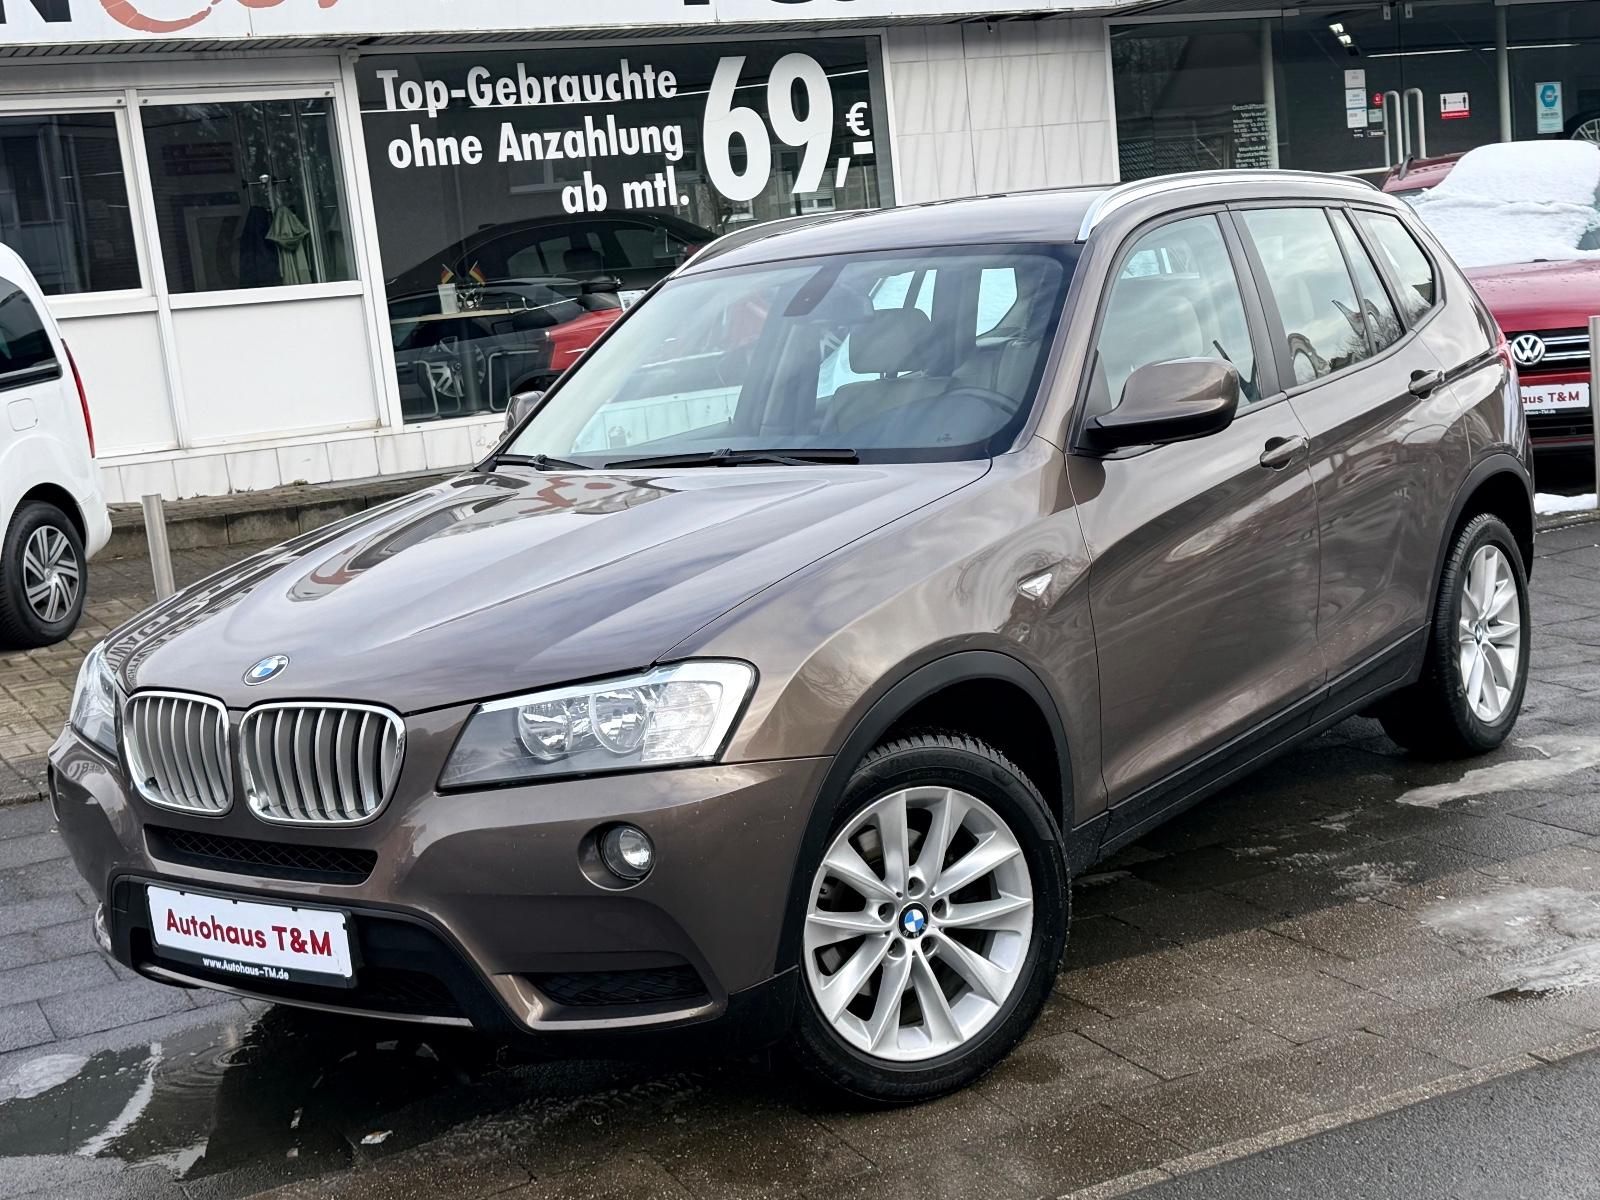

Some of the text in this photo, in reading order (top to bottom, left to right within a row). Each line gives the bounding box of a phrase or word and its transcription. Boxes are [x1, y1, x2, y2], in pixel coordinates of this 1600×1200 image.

[376, 58, 677, 118] Top-Gebrauchte
[388, 114, 684, 169] ohne Anzahlung
[561, 166, 690, 214] ab mtl.
[1548, 391, 1580, 402] T&M
[167, 908, 332, 956] Autohaus T&M
[203, 957, 289, 981] www.Autohaus-TM.de
